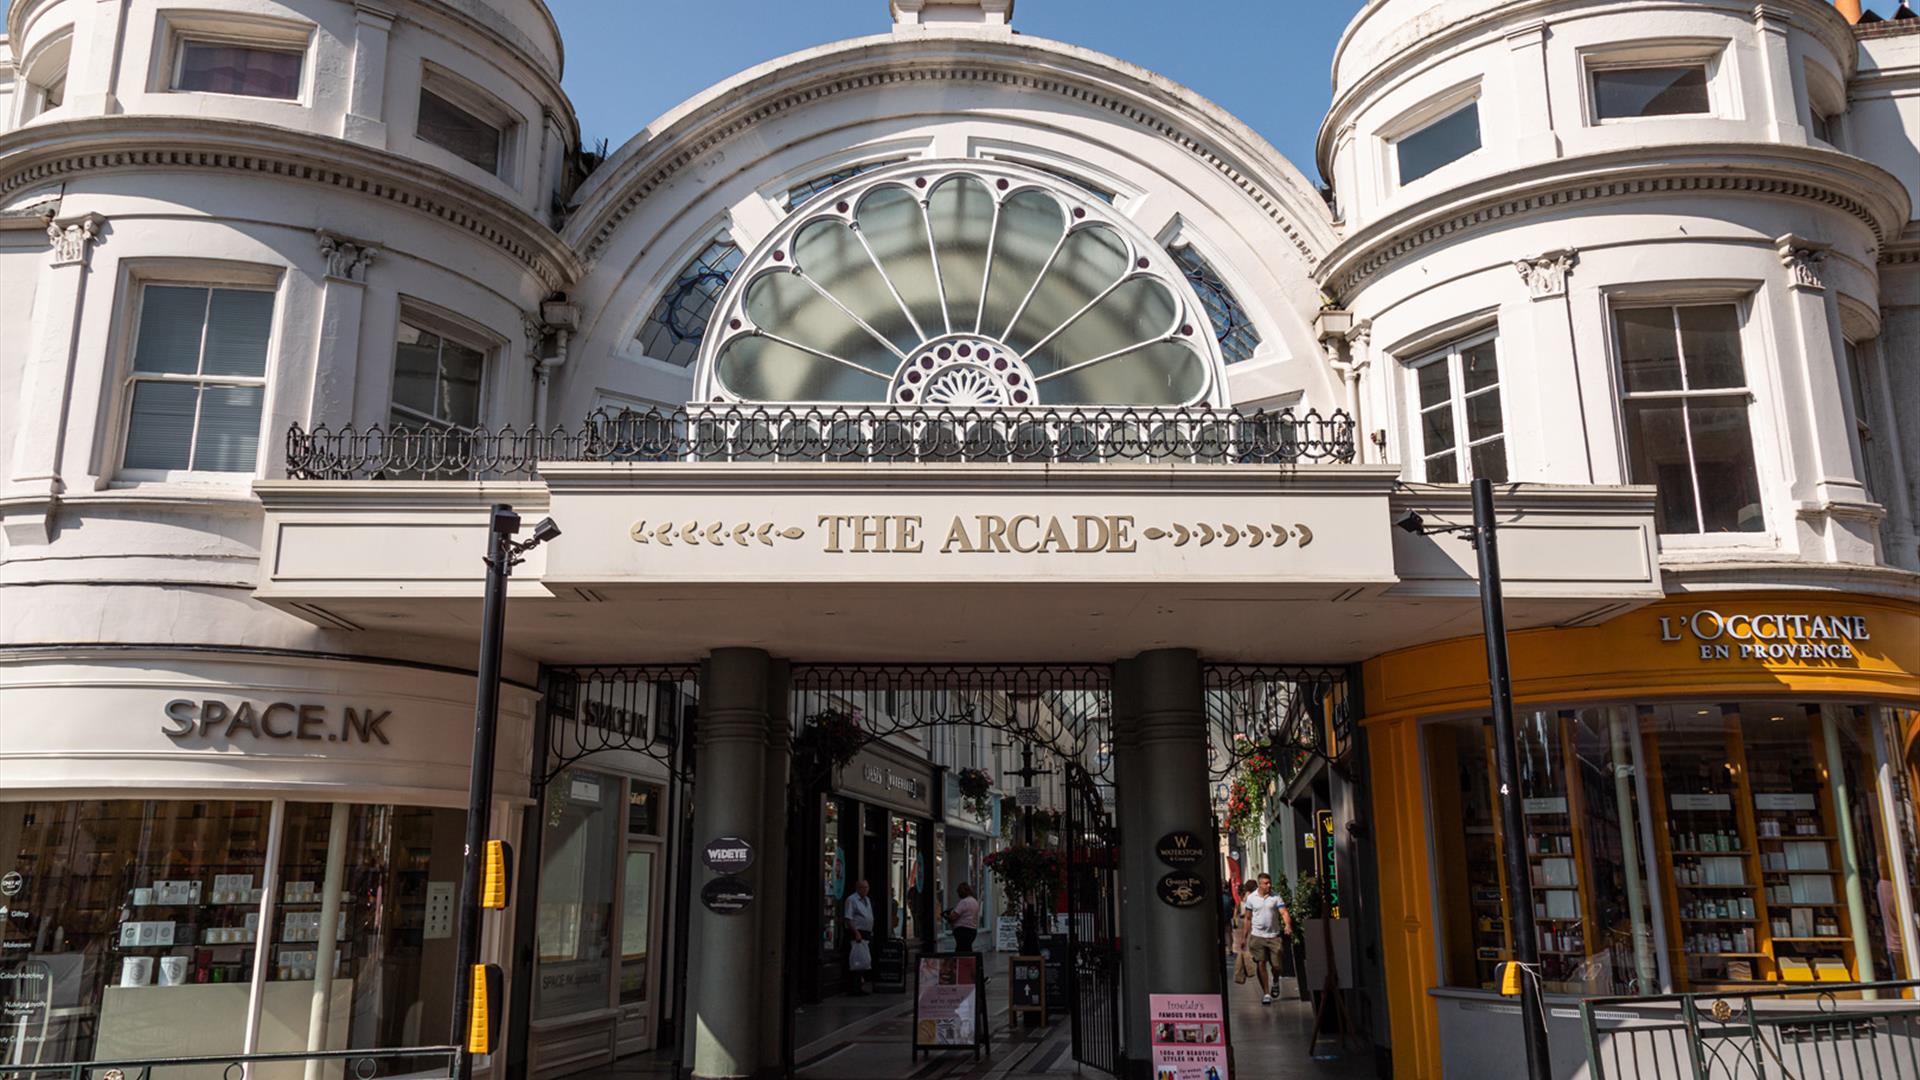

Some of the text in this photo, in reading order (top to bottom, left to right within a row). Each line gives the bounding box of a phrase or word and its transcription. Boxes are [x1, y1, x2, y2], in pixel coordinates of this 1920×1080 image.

[818, 515, 1138, 553] THE ARCADE
[1660, 609, 1870, 641] L'OCCITANE
[1701, 644, 1853, 659] EN PROVENCE
[161, 699, 392, 745] SPACE.NK
[1501, 784, 1509, 795] 4
[1174, 835, 1189, 848] W
[464, 844, 470, 856] 3
